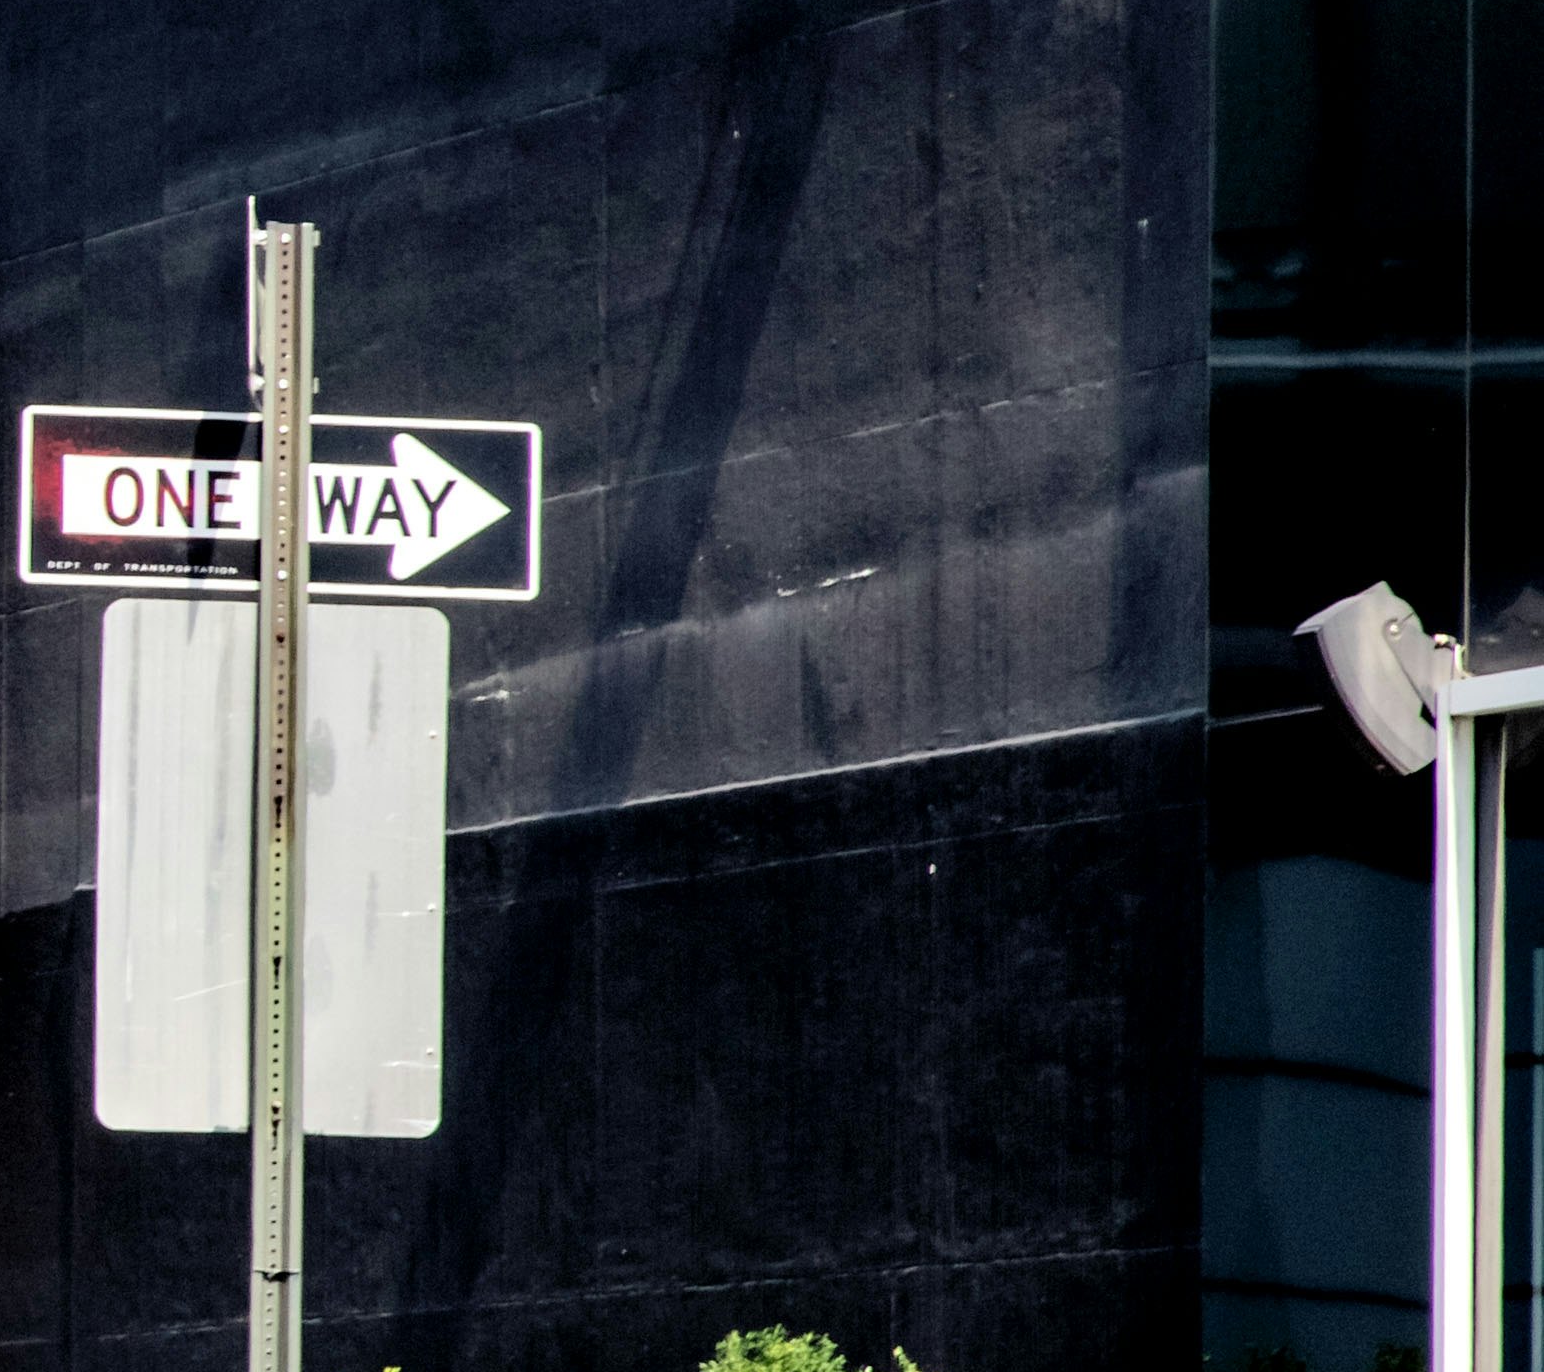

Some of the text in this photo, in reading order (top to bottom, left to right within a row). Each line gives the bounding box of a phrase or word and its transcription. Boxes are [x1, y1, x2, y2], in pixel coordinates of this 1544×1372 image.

[104, 466, 456, 539] ONE WAY
[93, 561, 111, 572] OF
[123, 562, 240, 576] TRANSPORTATION
